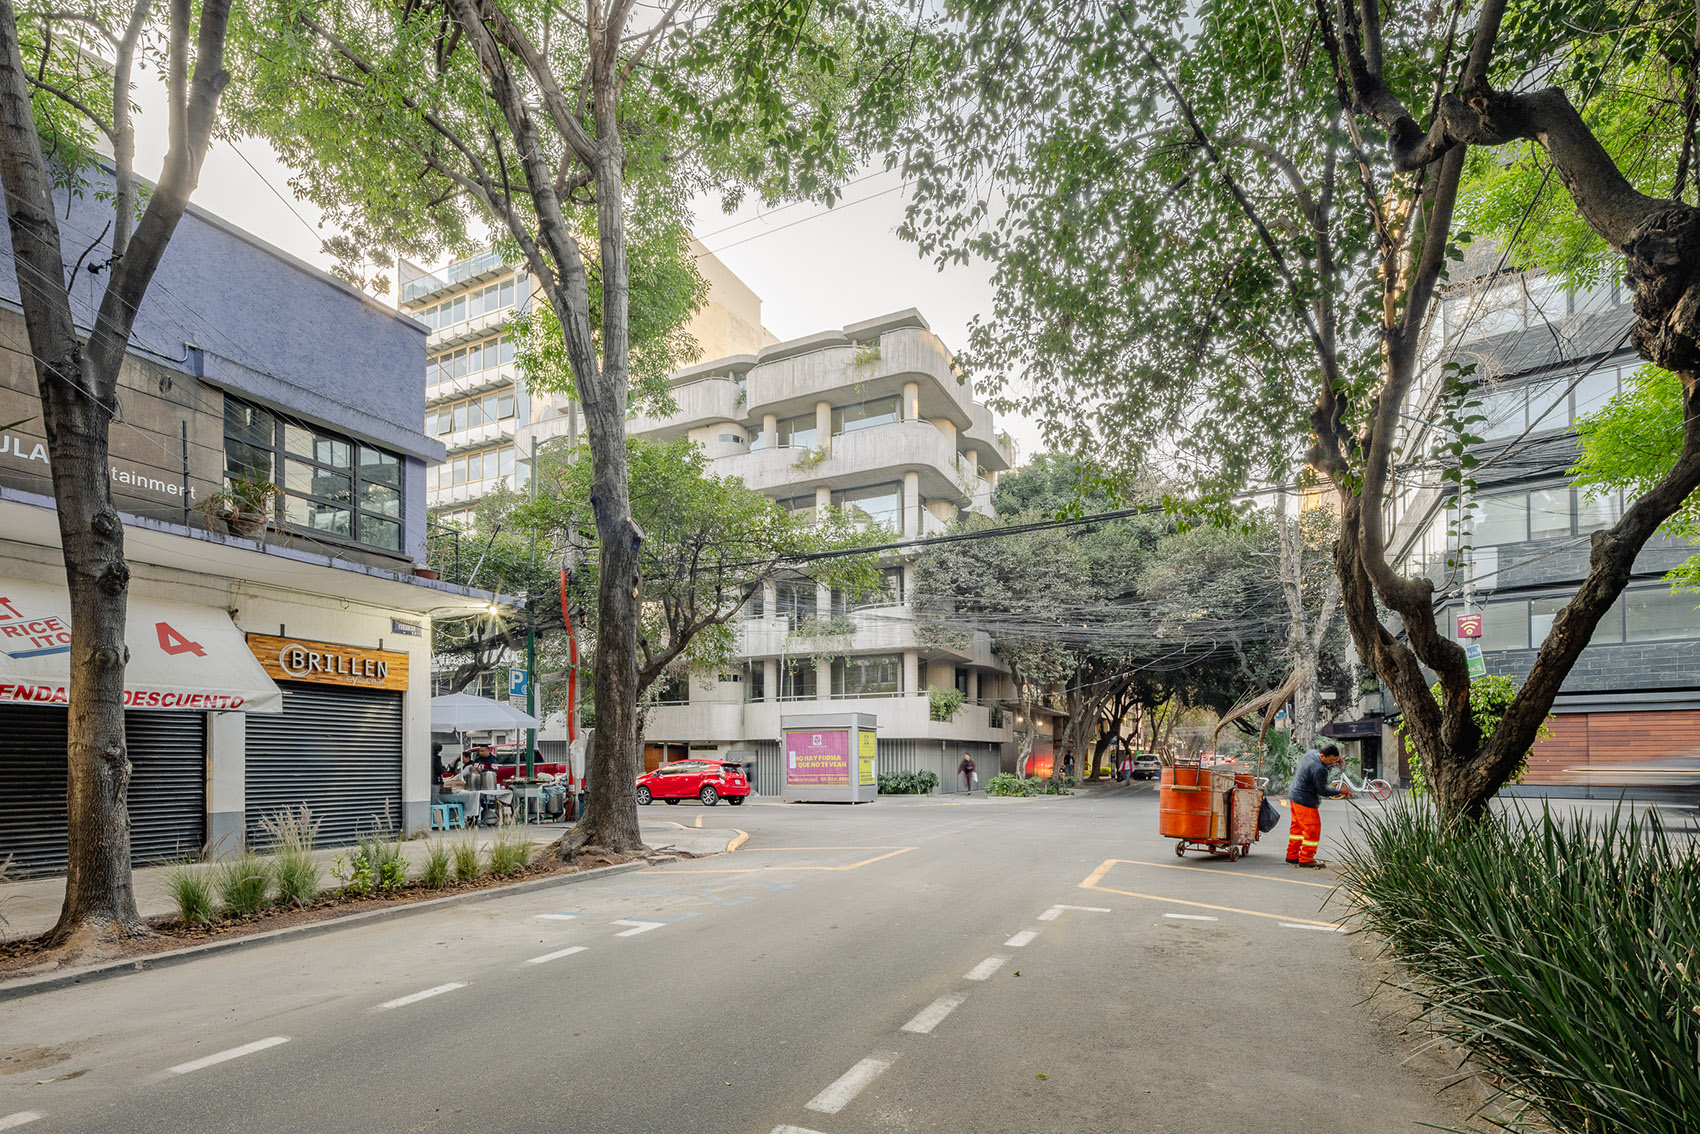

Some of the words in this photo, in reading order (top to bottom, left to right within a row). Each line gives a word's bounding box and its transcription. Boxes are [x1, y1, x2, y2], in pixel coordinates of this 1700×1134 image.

[155, 621, 208, 657] 4
[290, 650, 389, 678] BRILLEN
[346, 675, 386, 686] eyewear
[511, 670, 524, 690] P
